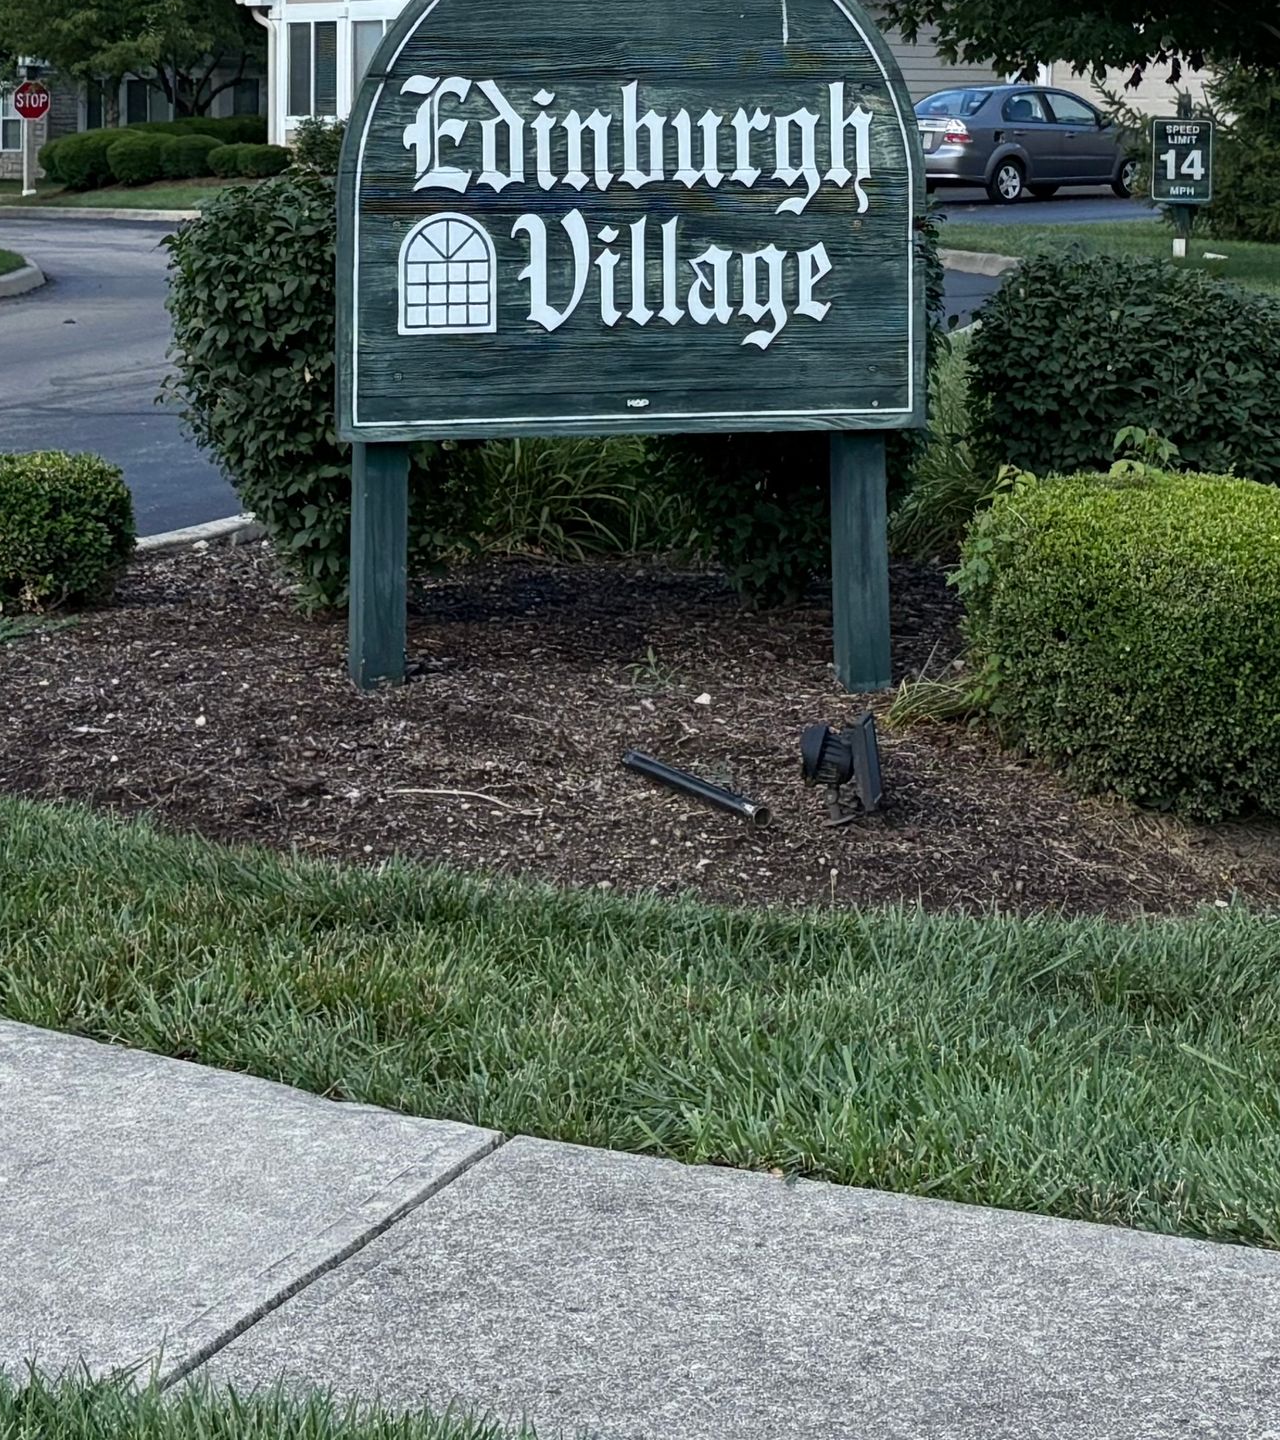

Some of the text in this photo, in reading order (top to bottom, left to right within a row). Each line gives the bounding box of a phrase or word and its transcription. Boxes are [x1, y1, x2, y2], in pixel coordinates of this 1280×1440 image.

[16, 93, 47, 107] STOP
[1166, 125, 1200, 134] SPEED
[400, 74, 873, 215] Edinburgh
[1168, 135, 1197, 144] LIMIT
[1160, 149, 1205, 180] 14
[1170, 186, 1195, 195] MPH
[511, 208, 832, 349] Village
